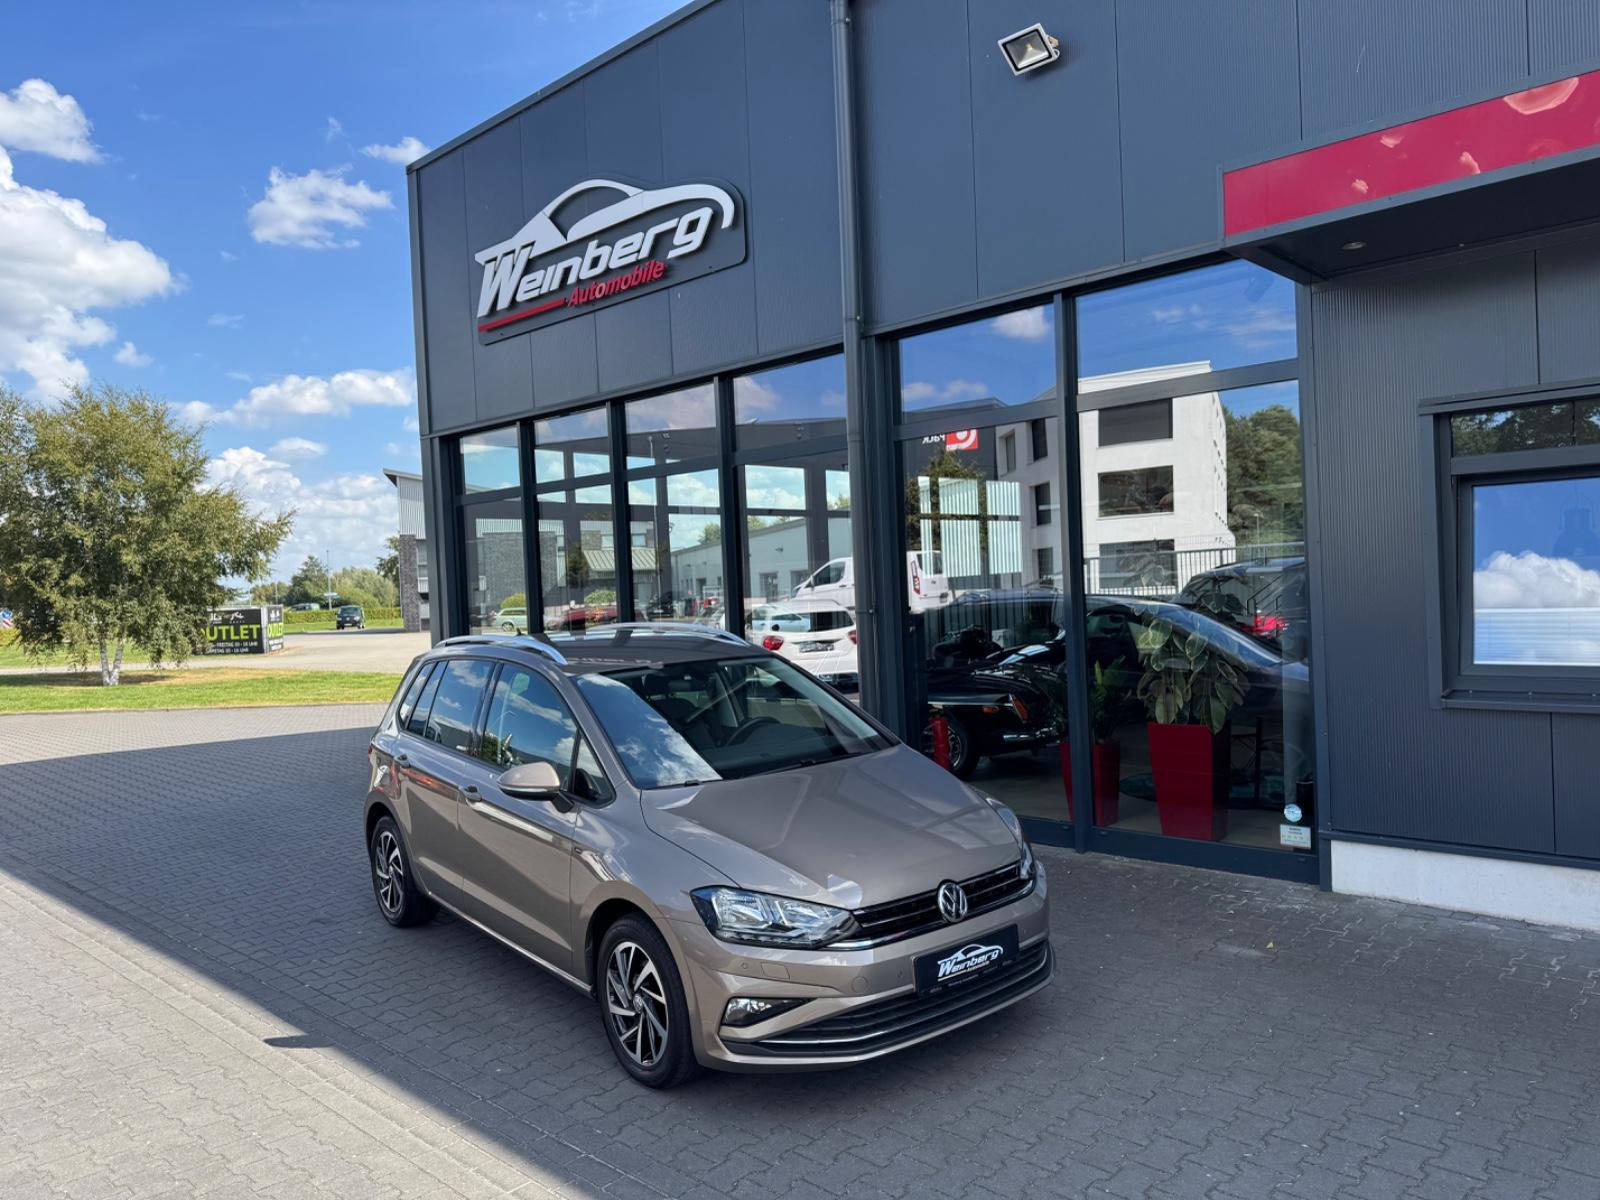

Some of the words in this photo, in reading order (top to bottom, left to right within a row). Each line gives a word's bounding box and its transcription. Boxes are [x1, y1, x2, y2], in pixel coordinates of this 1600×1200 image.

[477, 206, 714, 318] Weinberg
[567, 260, 667, 307] Automobile
[937, 949, 999, 978] Weinberg
